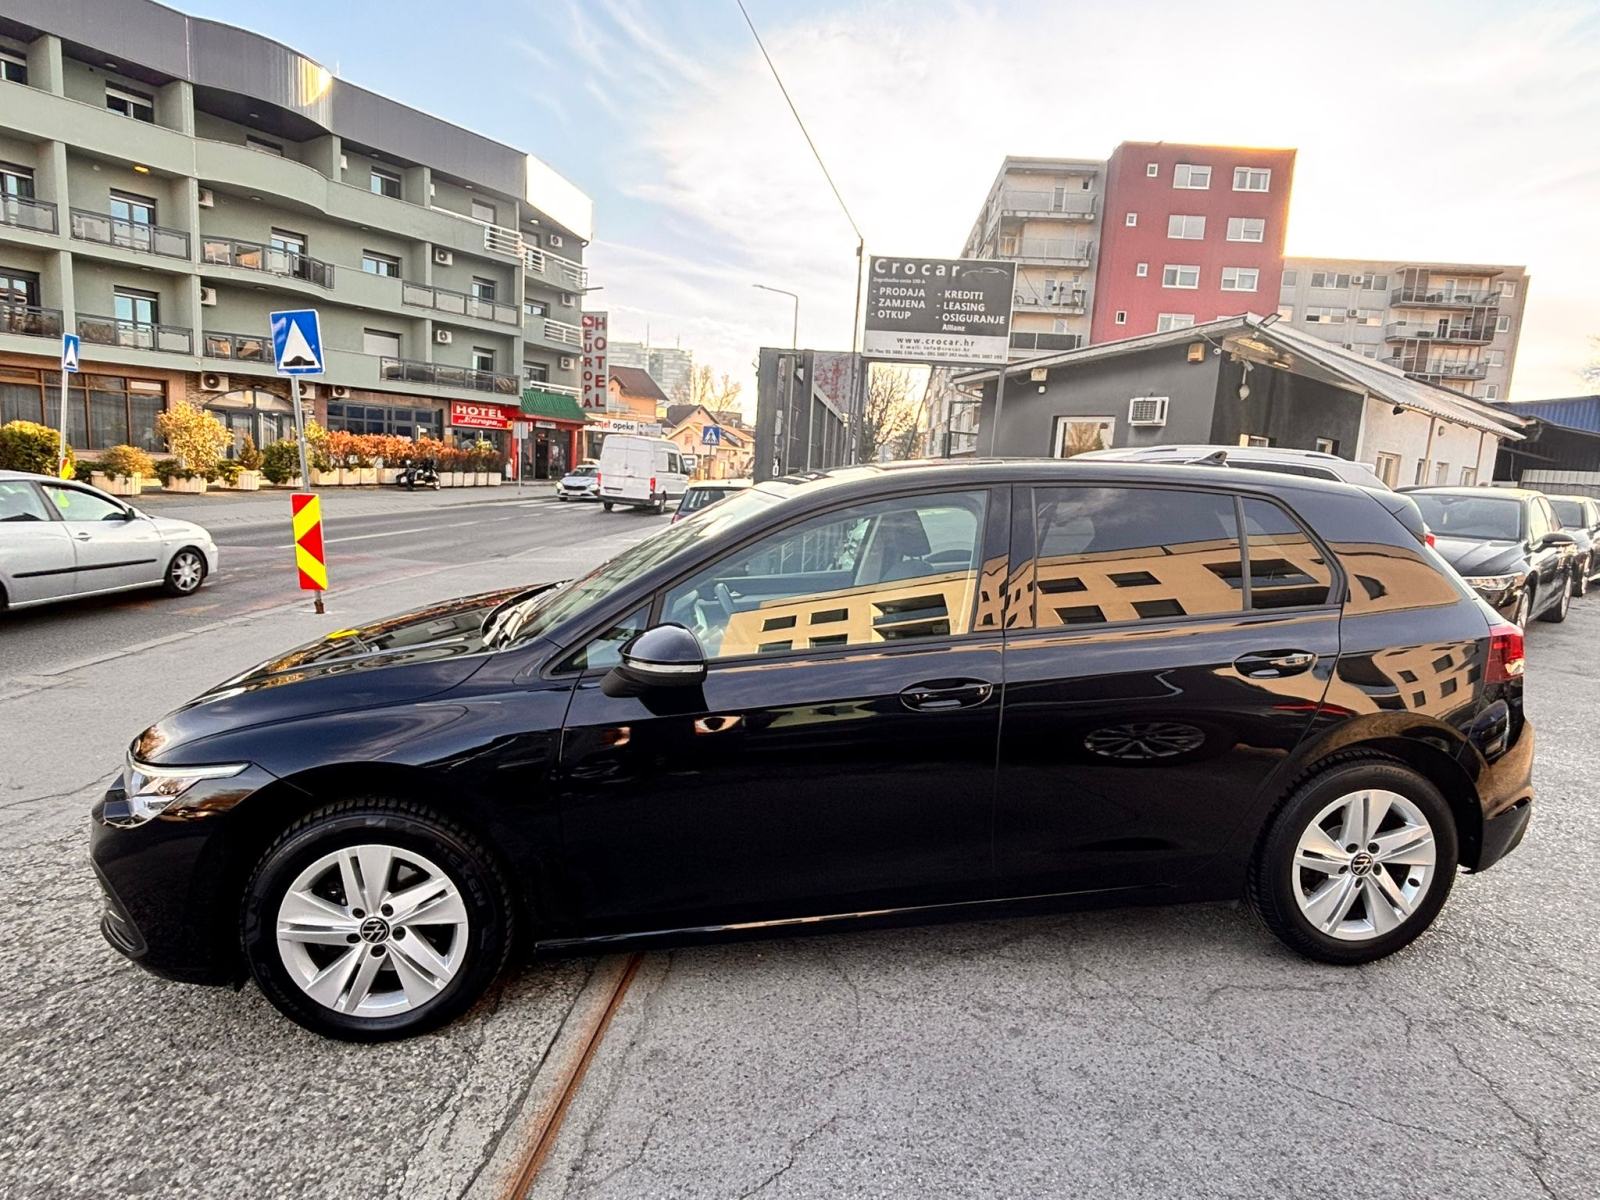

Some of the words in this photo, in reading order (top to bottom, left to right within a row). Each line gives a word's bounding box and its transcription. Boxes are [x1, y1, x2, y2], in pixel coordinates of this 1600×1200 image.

[874, 258, 961, 277] Crocar
[879, 287, 926, 298] PRODAJA
[944, 290, 984, 300] KREDITI
[878, 298, 926, 309] ZAMJENA
[943, 302, 986, 312] LEASING
[877, 310, 912, 320] OTKUP
[942, 313, 1006, 325] OSIGURANJE
[896, 336, 976, 348] www.crocar.hr
[594, 316, 606, 407] HOTEL
[583, 329, 593, 408] EUROPA
[456, 405, 505, 419] HOTEL
[612, 421, 635, 431] opeke
